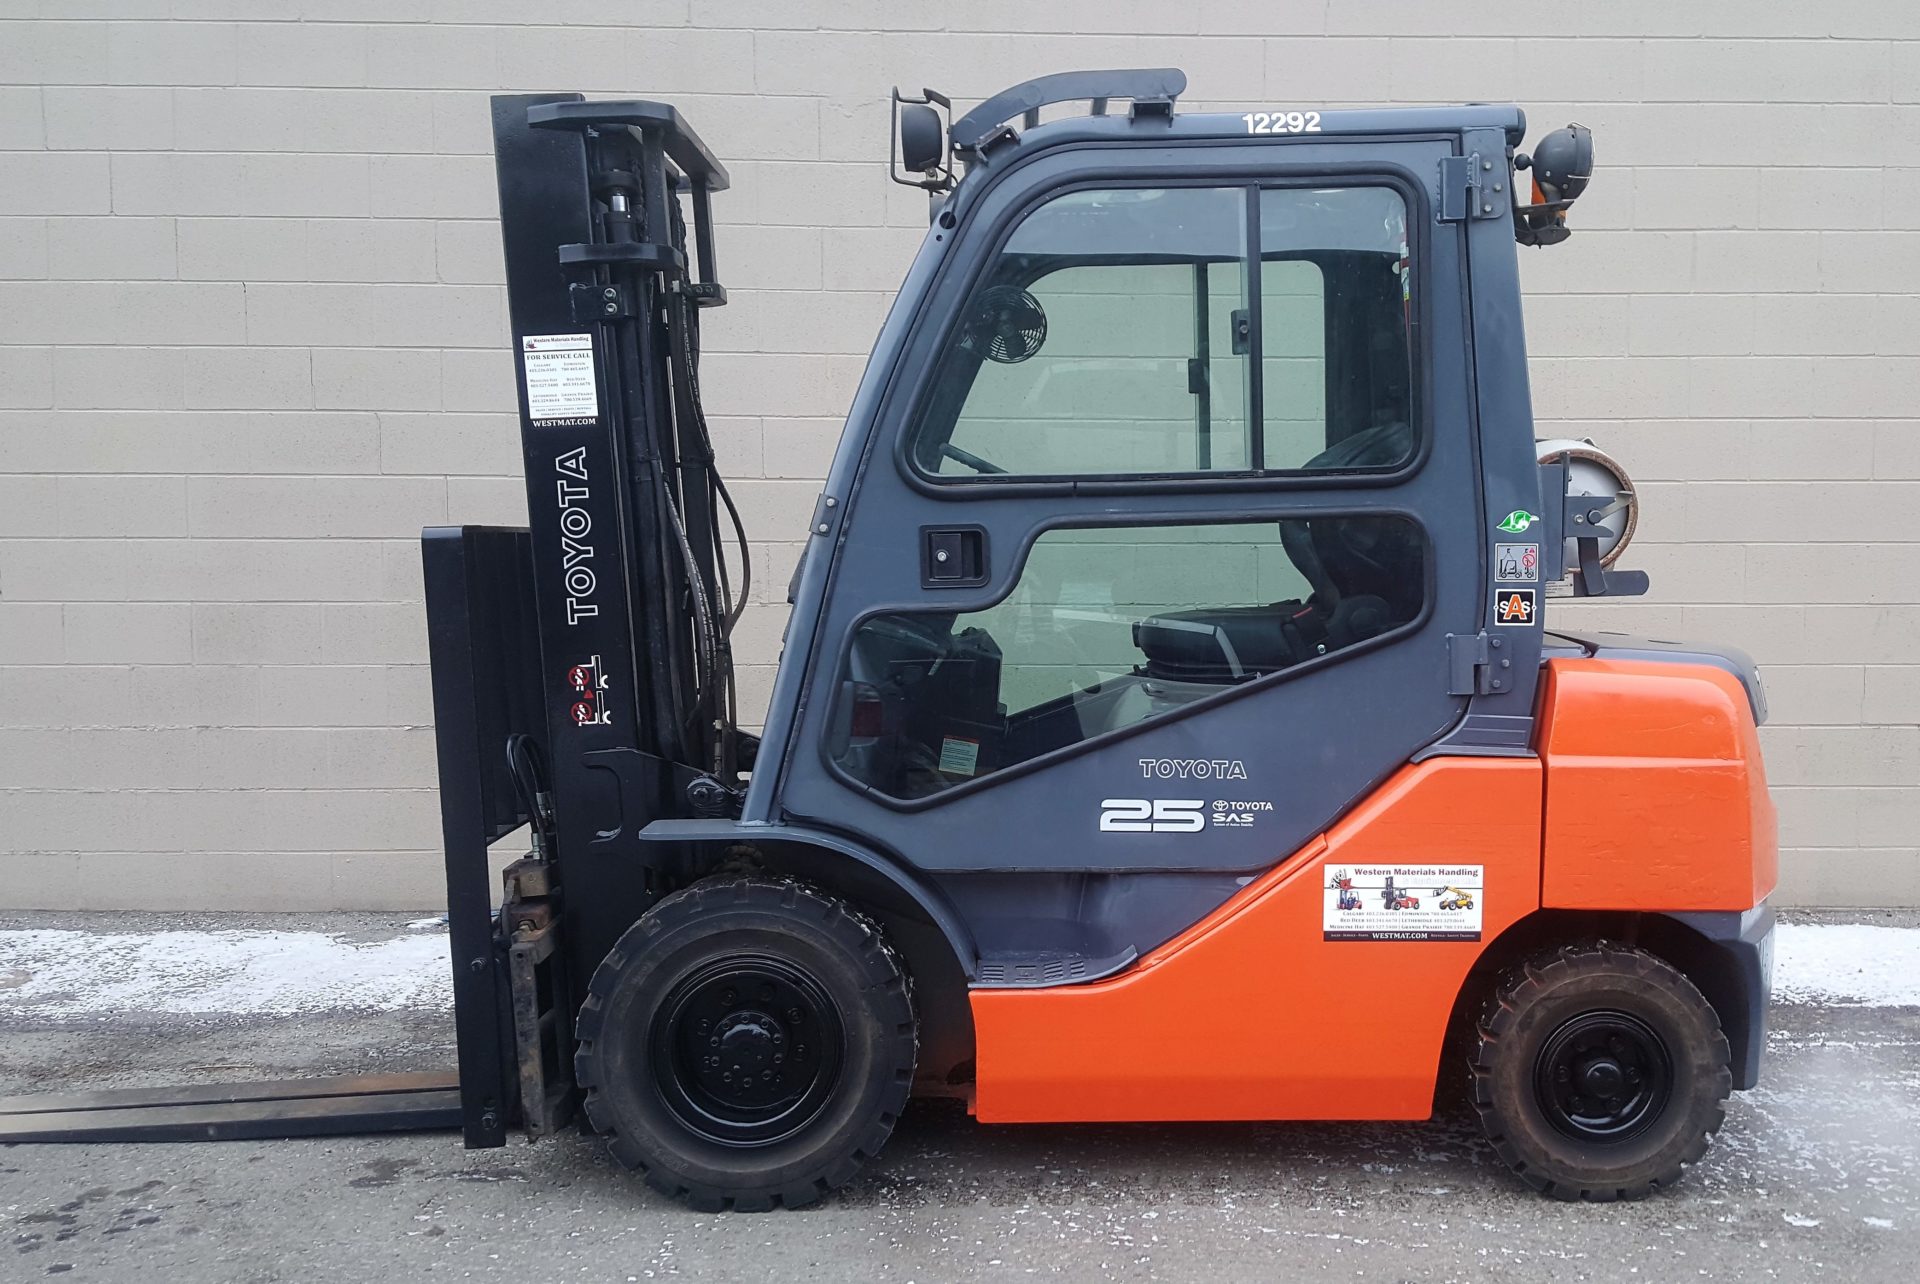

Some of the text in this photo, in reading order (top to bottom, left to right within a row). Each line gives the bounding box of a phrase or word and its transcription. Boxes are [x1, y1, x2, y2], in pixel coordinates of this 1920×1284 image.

[1242, 112, 1321, 133] 12292
[533, 418, 596, 427] WESTMAT.COM
[556, 446, 598, 625] TOYOTA
[1499, 594, 1531, 620] SAS
[1139, 759, 1247, 779] TOYOTA
[1100, 799, 1205, 832] 25
[1230, 801, 1273, 811] TOYOTA
[1212, 813, 1254, 822] SAS
[1438, 868, 1478, 877] Handling
